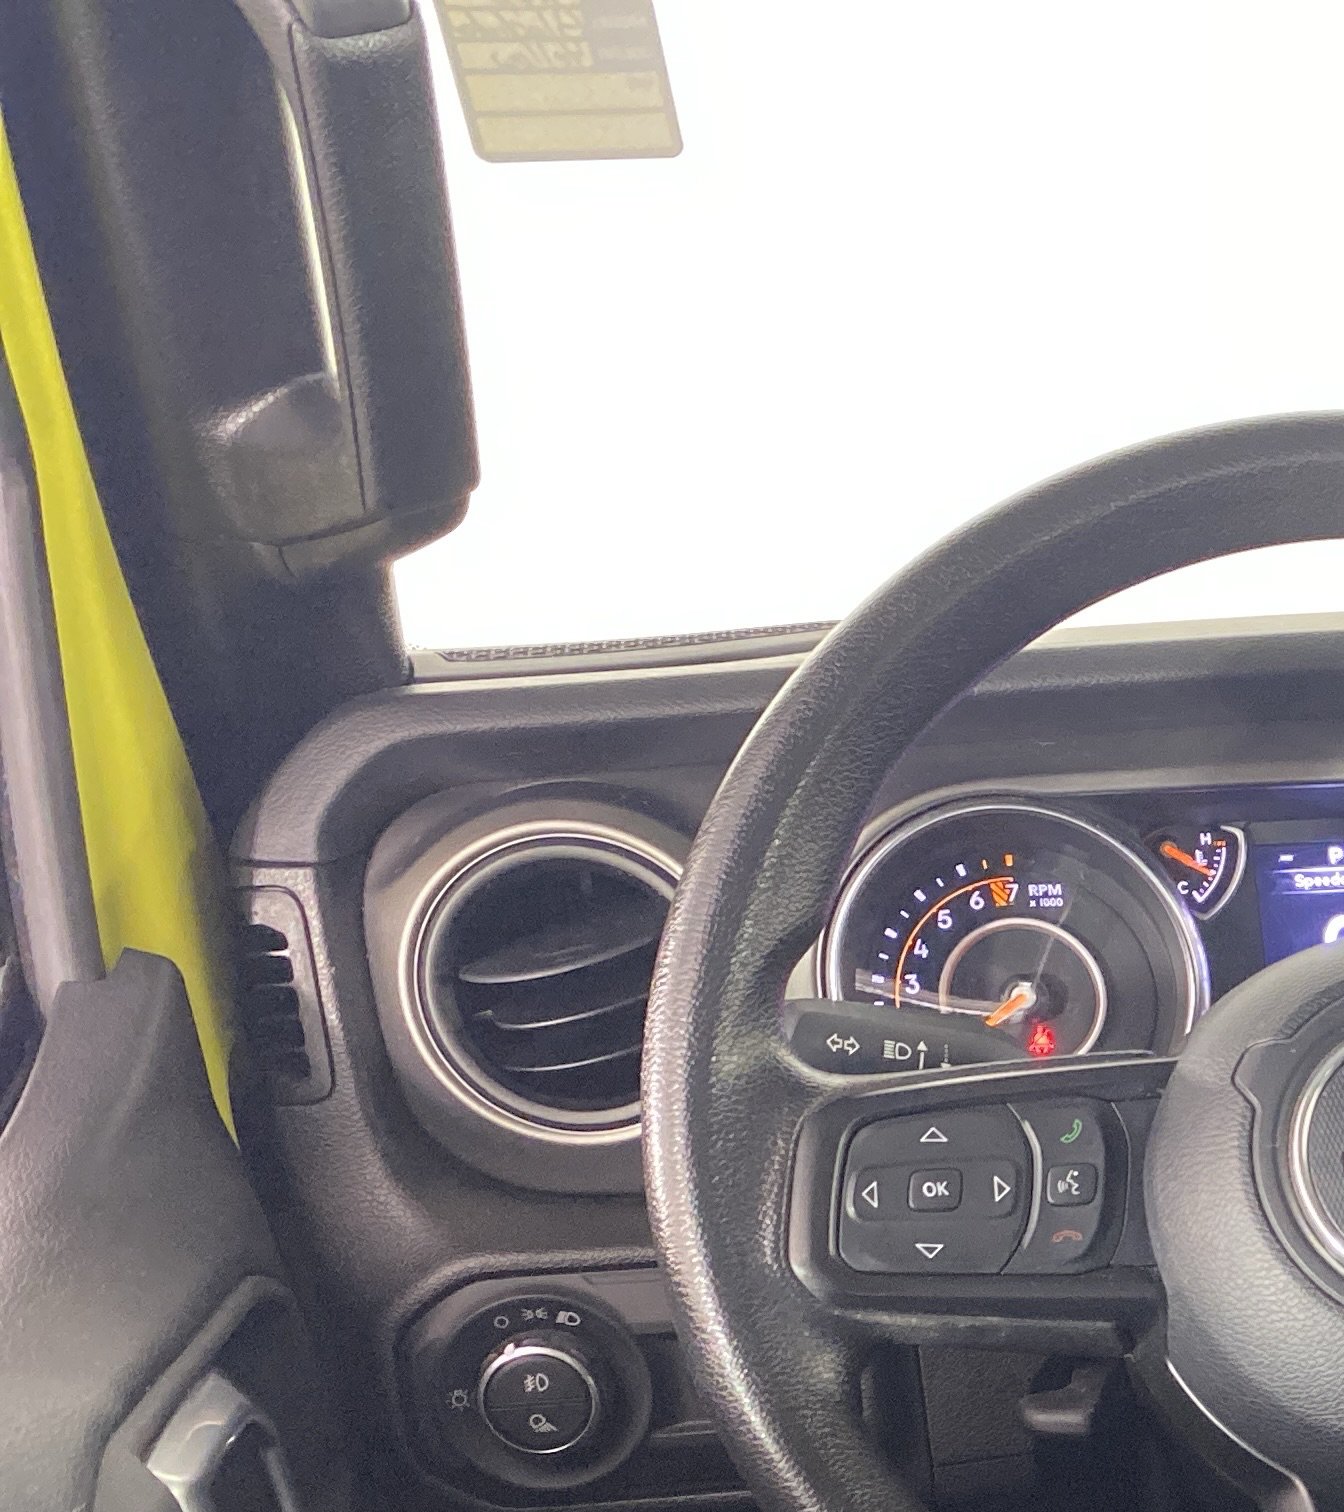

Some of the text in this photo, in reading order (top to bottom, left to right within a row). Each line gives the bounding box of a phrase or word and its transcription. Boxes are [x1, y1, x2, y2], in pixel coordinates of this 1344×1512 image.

[1200, 832, 1211, 846] H
[1328, 846, 1344, 865] P
[1005, 883, 1019, 903] 7
[1028, 883, 1062, 897] RPM
[1177, 880, 1189, 895] C
[970, 890, 985, 910] 6
[1039, 897, 1064, 908] 1000
[937, 910, 953, 929] 5
[913, 942, 929, 959] 4
[905, 974, 921, 994] 3
[922, 1180, 950, 1197] OK
